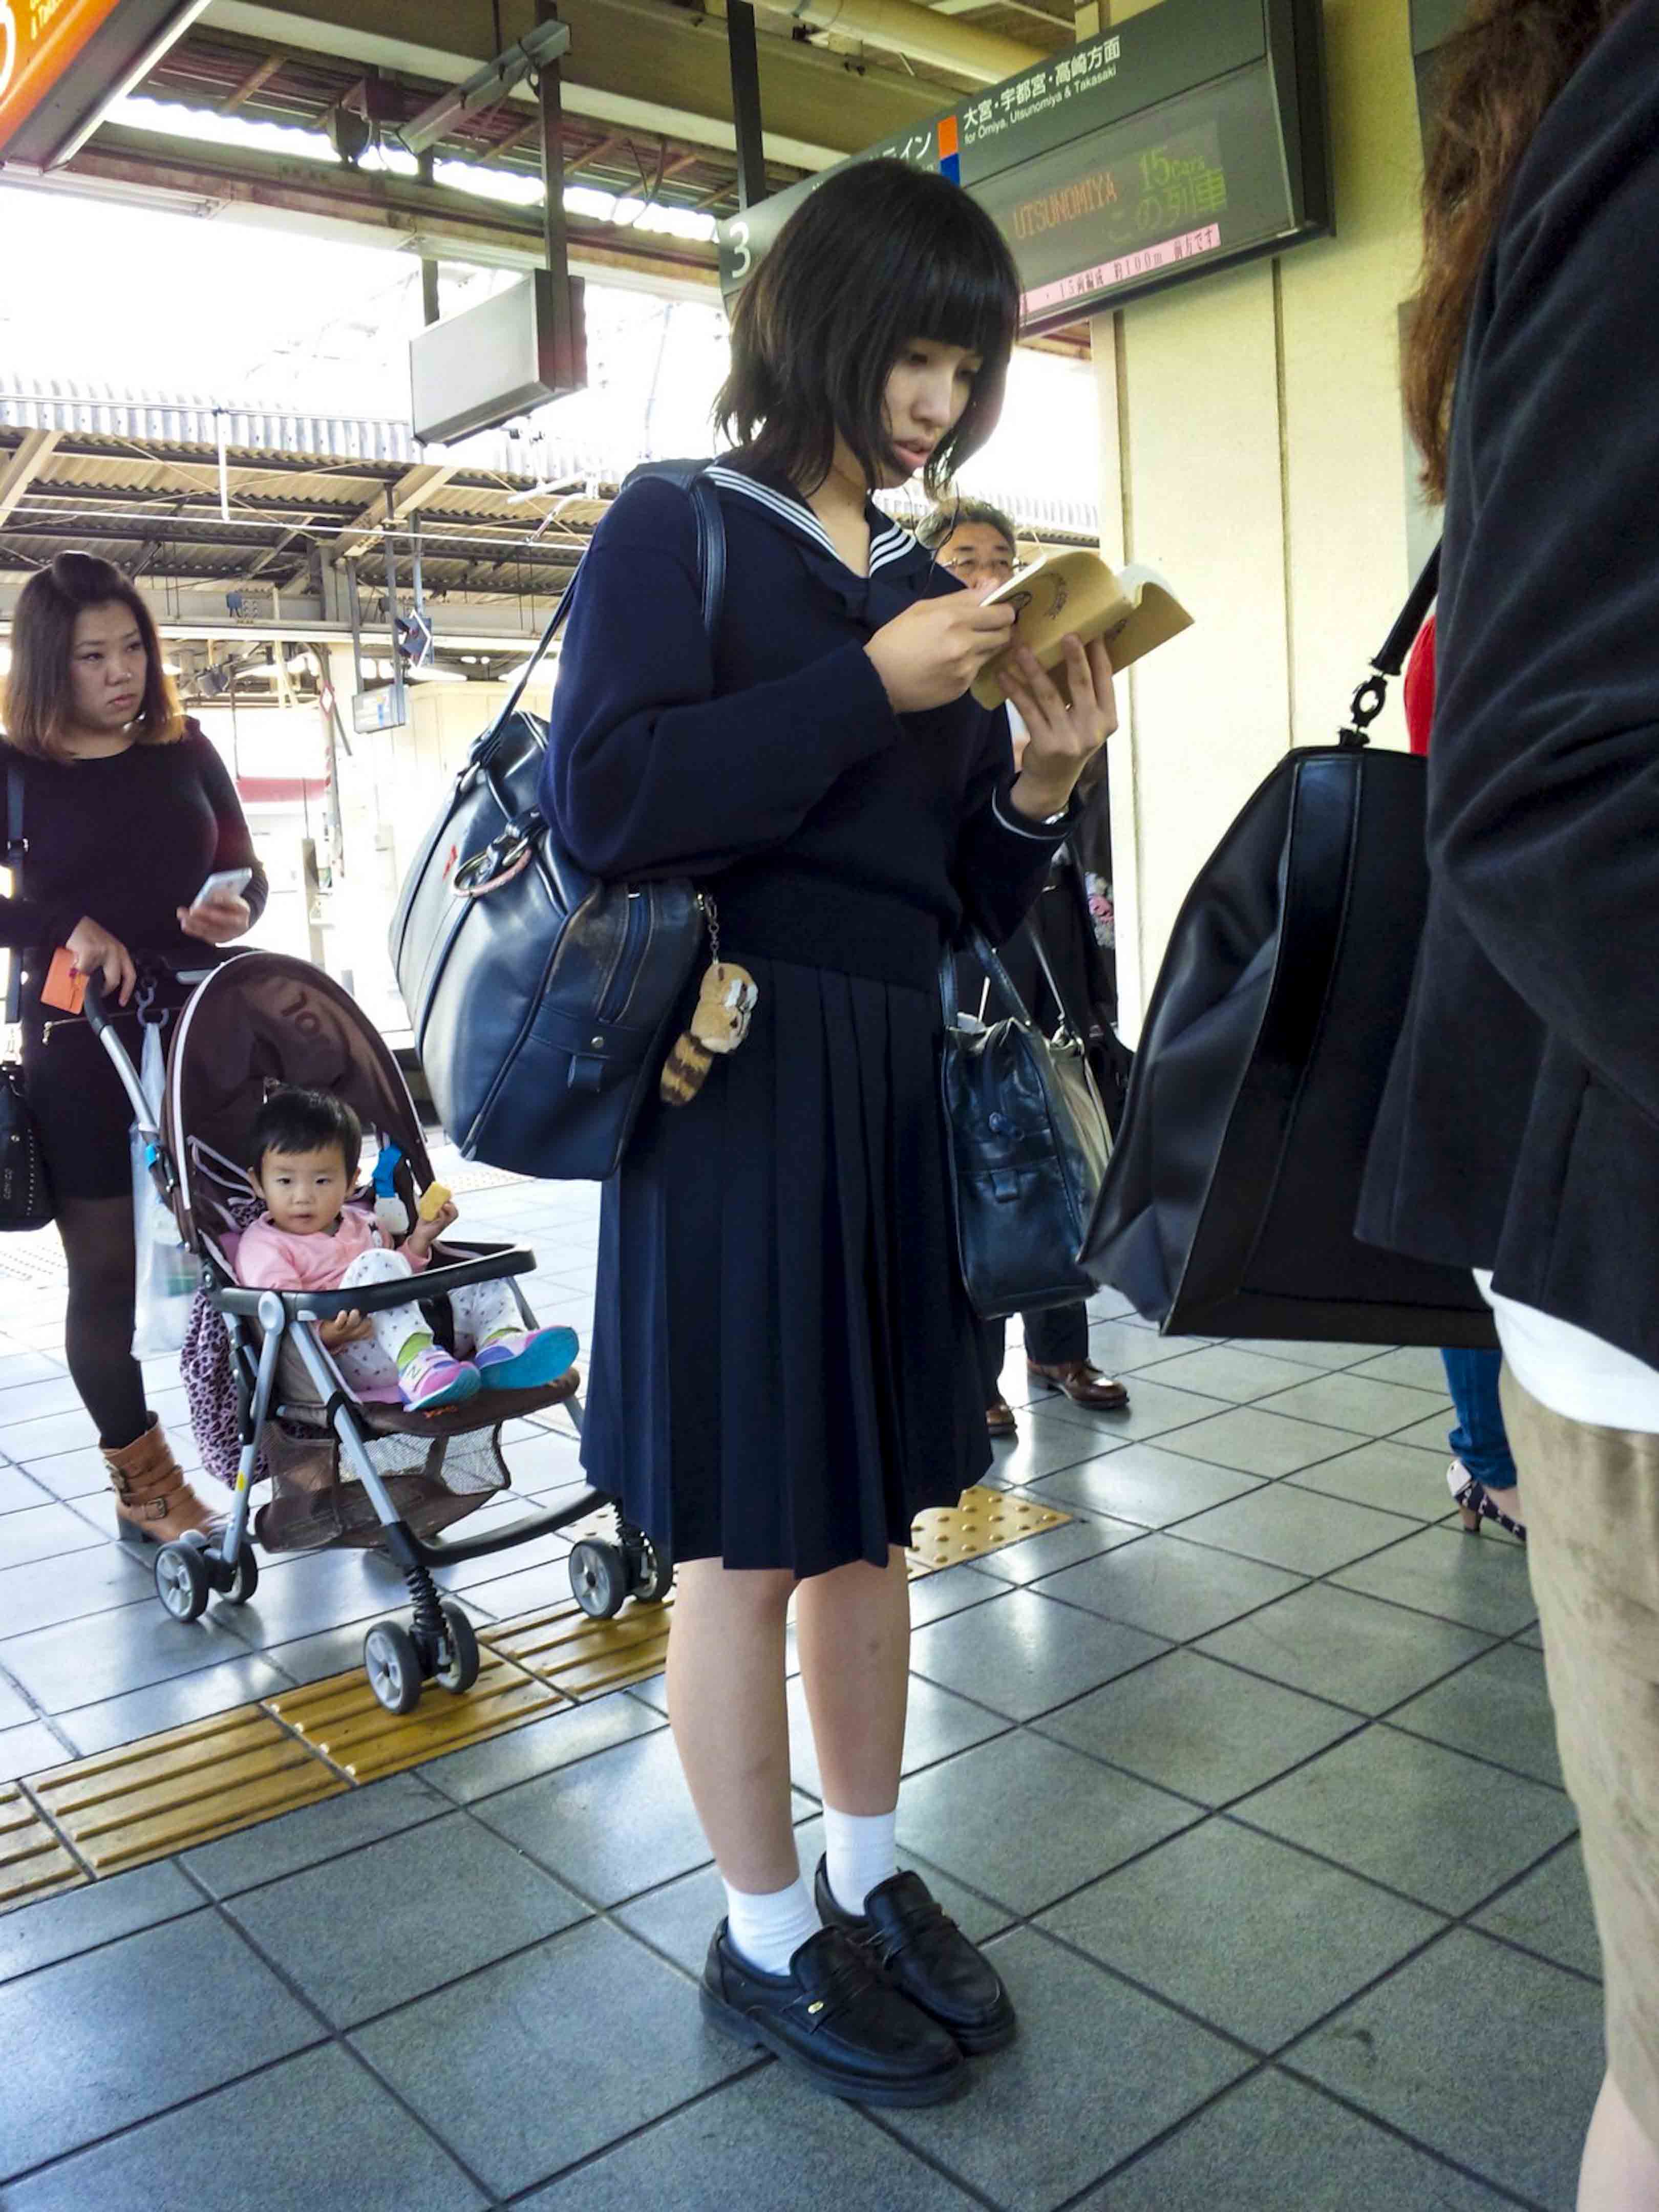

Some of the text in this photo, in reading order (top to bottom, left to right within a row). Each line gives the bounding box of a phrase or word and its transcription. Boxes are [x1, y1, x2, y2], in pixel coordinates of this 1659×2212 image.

[963, 35, 1121, 130] 大宮・宇都宮・高崎方面
[964, 131, 975, 145] for
[1010, 93, 1062, 123] Utsunomiya
[1064, 84, 1072, 98] &
[1074, 63, 1117, 94] Takasaki
[1014, 172, 1117, 238] UTSUNOMIYA
[729, 221, 751, 278] 3
